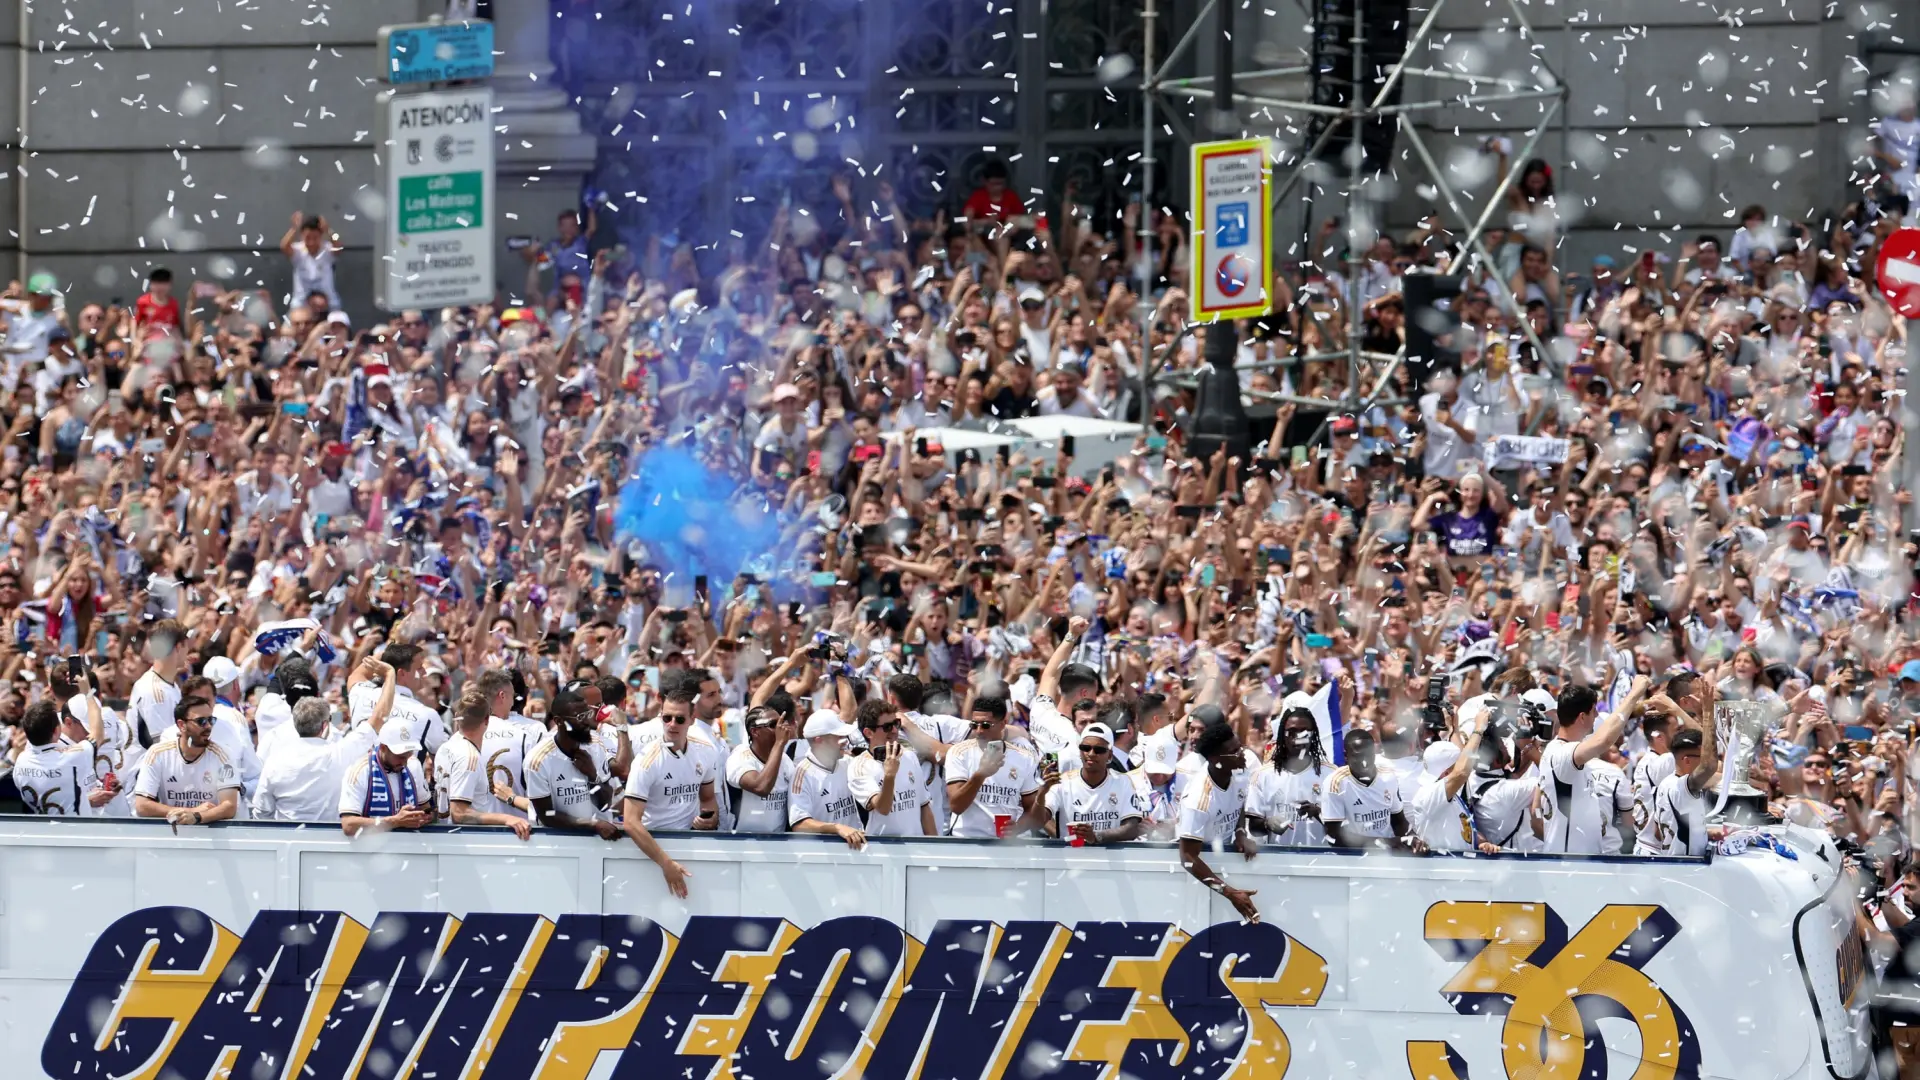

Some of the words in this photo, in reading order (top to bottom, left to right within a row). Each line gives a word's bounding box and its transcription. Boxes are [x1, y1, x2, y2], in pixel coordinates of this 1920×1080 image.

[399, 98, 484, 128] ATENCIÓN
[405, 196, 426, 211] Los
[167, 789, 214, 801] Emirates
[664, 782, 700, 797] Emirate
[980, 782, 1017, 796] mirates
[1073, 811, 1119, 822] Emirates
[41, 905, 1328, 1080] CAMPEONES
[1406, 899, 1700, 1080] 36
